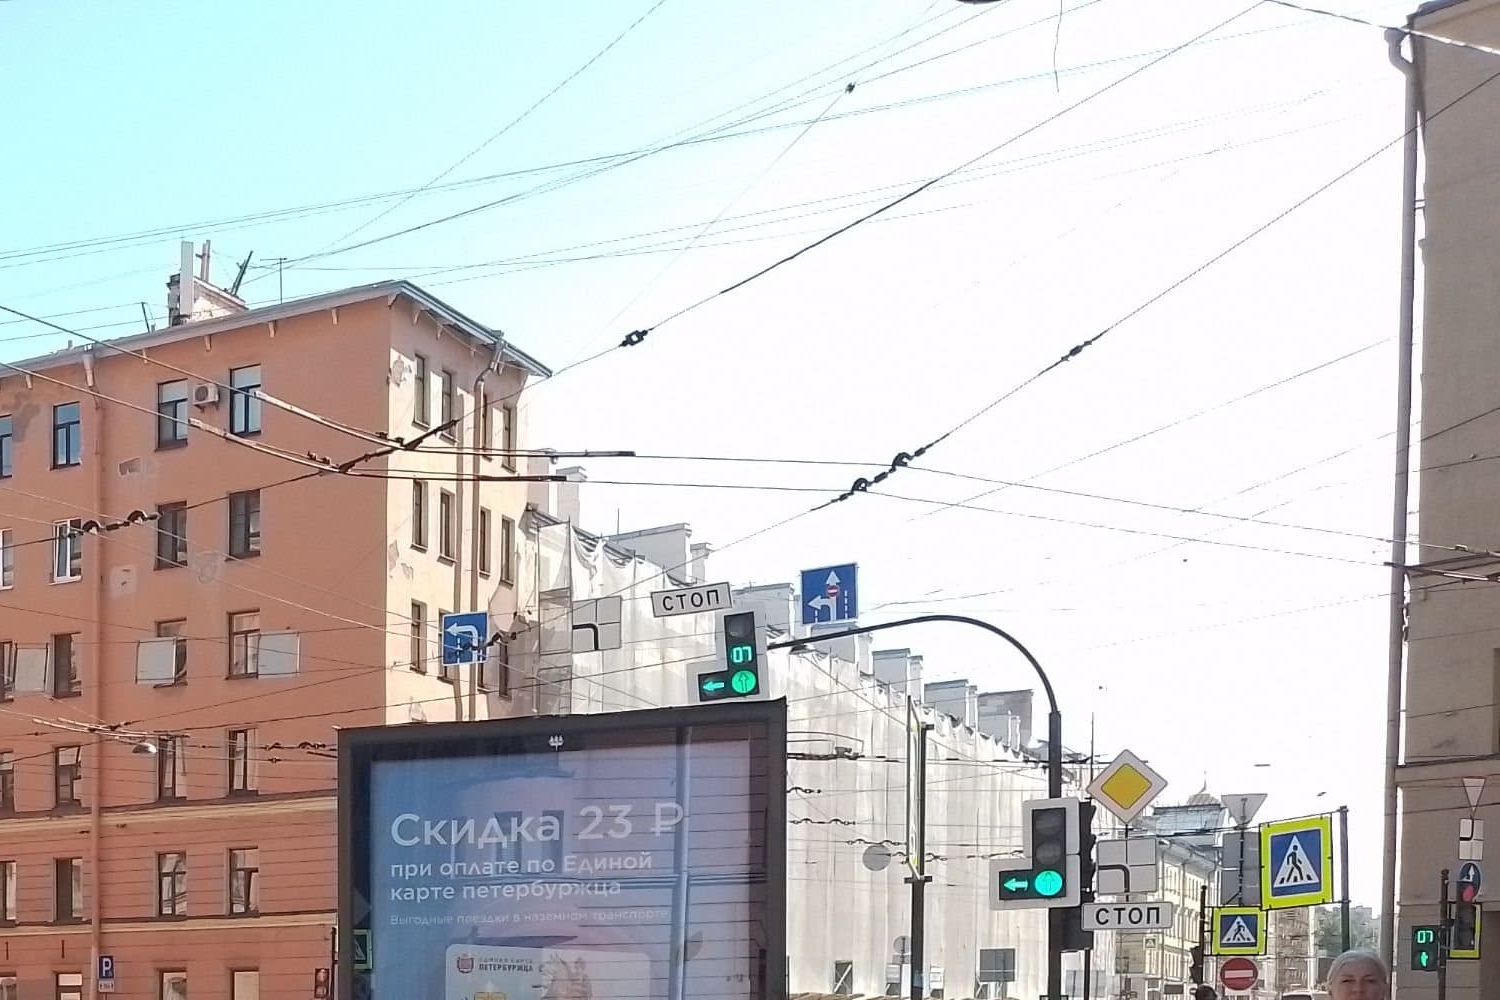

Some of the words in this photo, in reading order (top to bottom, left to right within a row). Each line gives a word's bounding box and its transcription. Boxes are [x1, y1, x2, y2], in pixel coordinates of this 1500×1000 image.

[662, 589, 719, 611] СТОП
[732, 646, 752, 663] 07
[391, 813, 560, 848] Скидка
[578, 804, 632, 840] 23
[391, 863, 432, 880] при
[440, 859, 519, 876] оплате
[527, 859, 555, 874] по
[564, 851, 652, 874] Единой
[391, 886, 455, 903] карте
[462, 879, 621, 900] петербуржца
[1095, 907, 1160, 925] СТОП
[1417, 930, 1433, 943] 07
